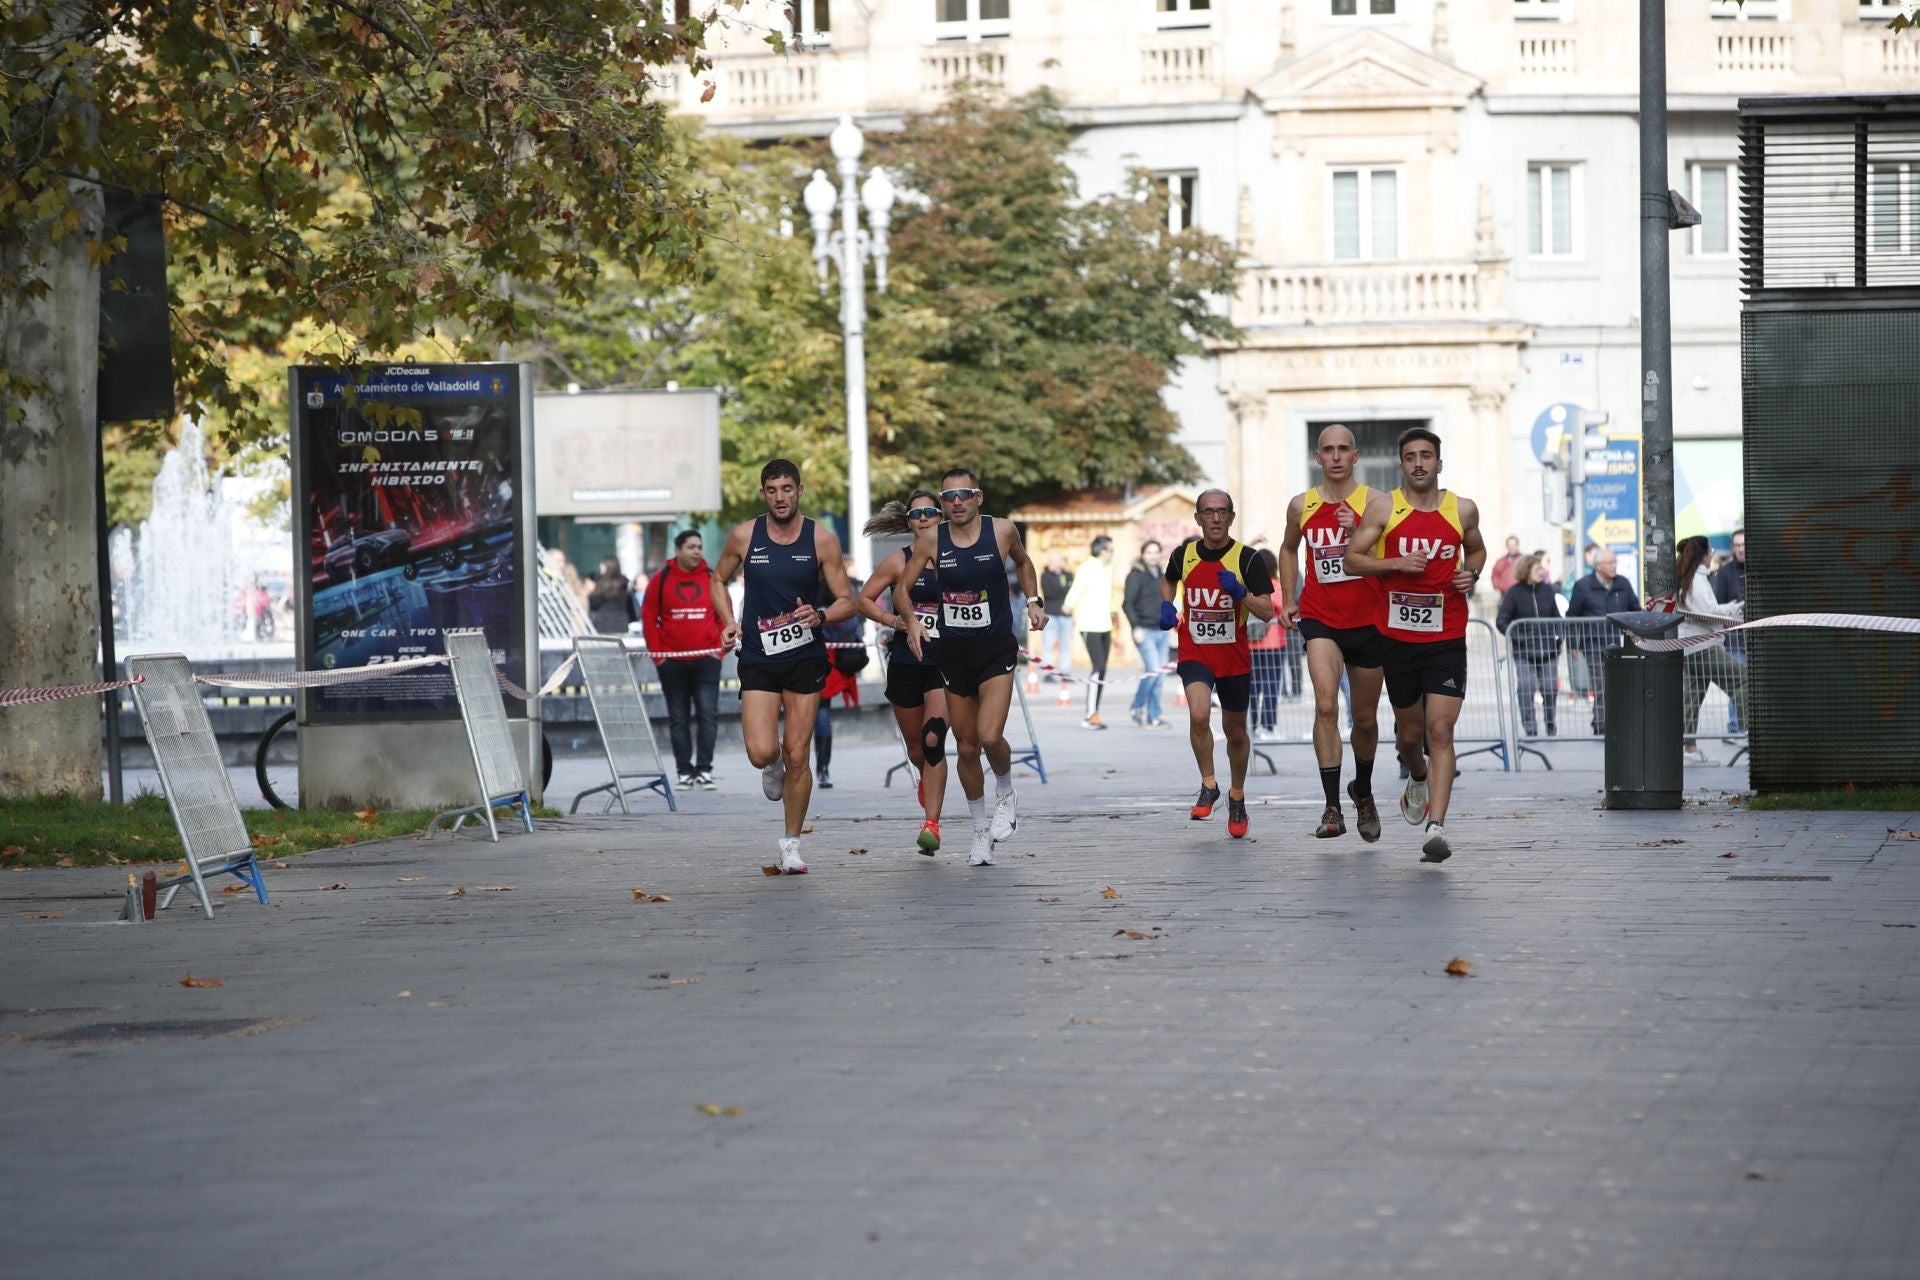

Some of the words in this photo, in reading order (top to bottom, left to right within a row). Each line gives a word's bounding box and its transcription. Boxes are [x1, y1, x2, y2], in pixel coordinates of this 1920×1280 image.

[385, 367, 430, 376] JCDecaux
[411, 382, 424, 392] de
[426, 380, 480, 391] Valladolid
[341, 431, 420, 443] OMODA
[338, 460, 479, 473] INFINITAMENTE
[371, 474, 445, 486] HÍBRIDO
[1586, 497, 1618, 511] OFFICE
[1399, 536, 1456, 560] UVa
[1321, 559, 1344, 576] 95
[1187, 587, 1233, 609] UVa
[949, 605, 983, 621] 788
[1399, 606, 1432, 624] 952
[341, 629, 366, 638] ONE
[371, 629, 397, 637] CAR
[409, 628, 436, 637] TWO
[768, 624, 803, 647] 789
[1196, 623, 1227, 637] 954
